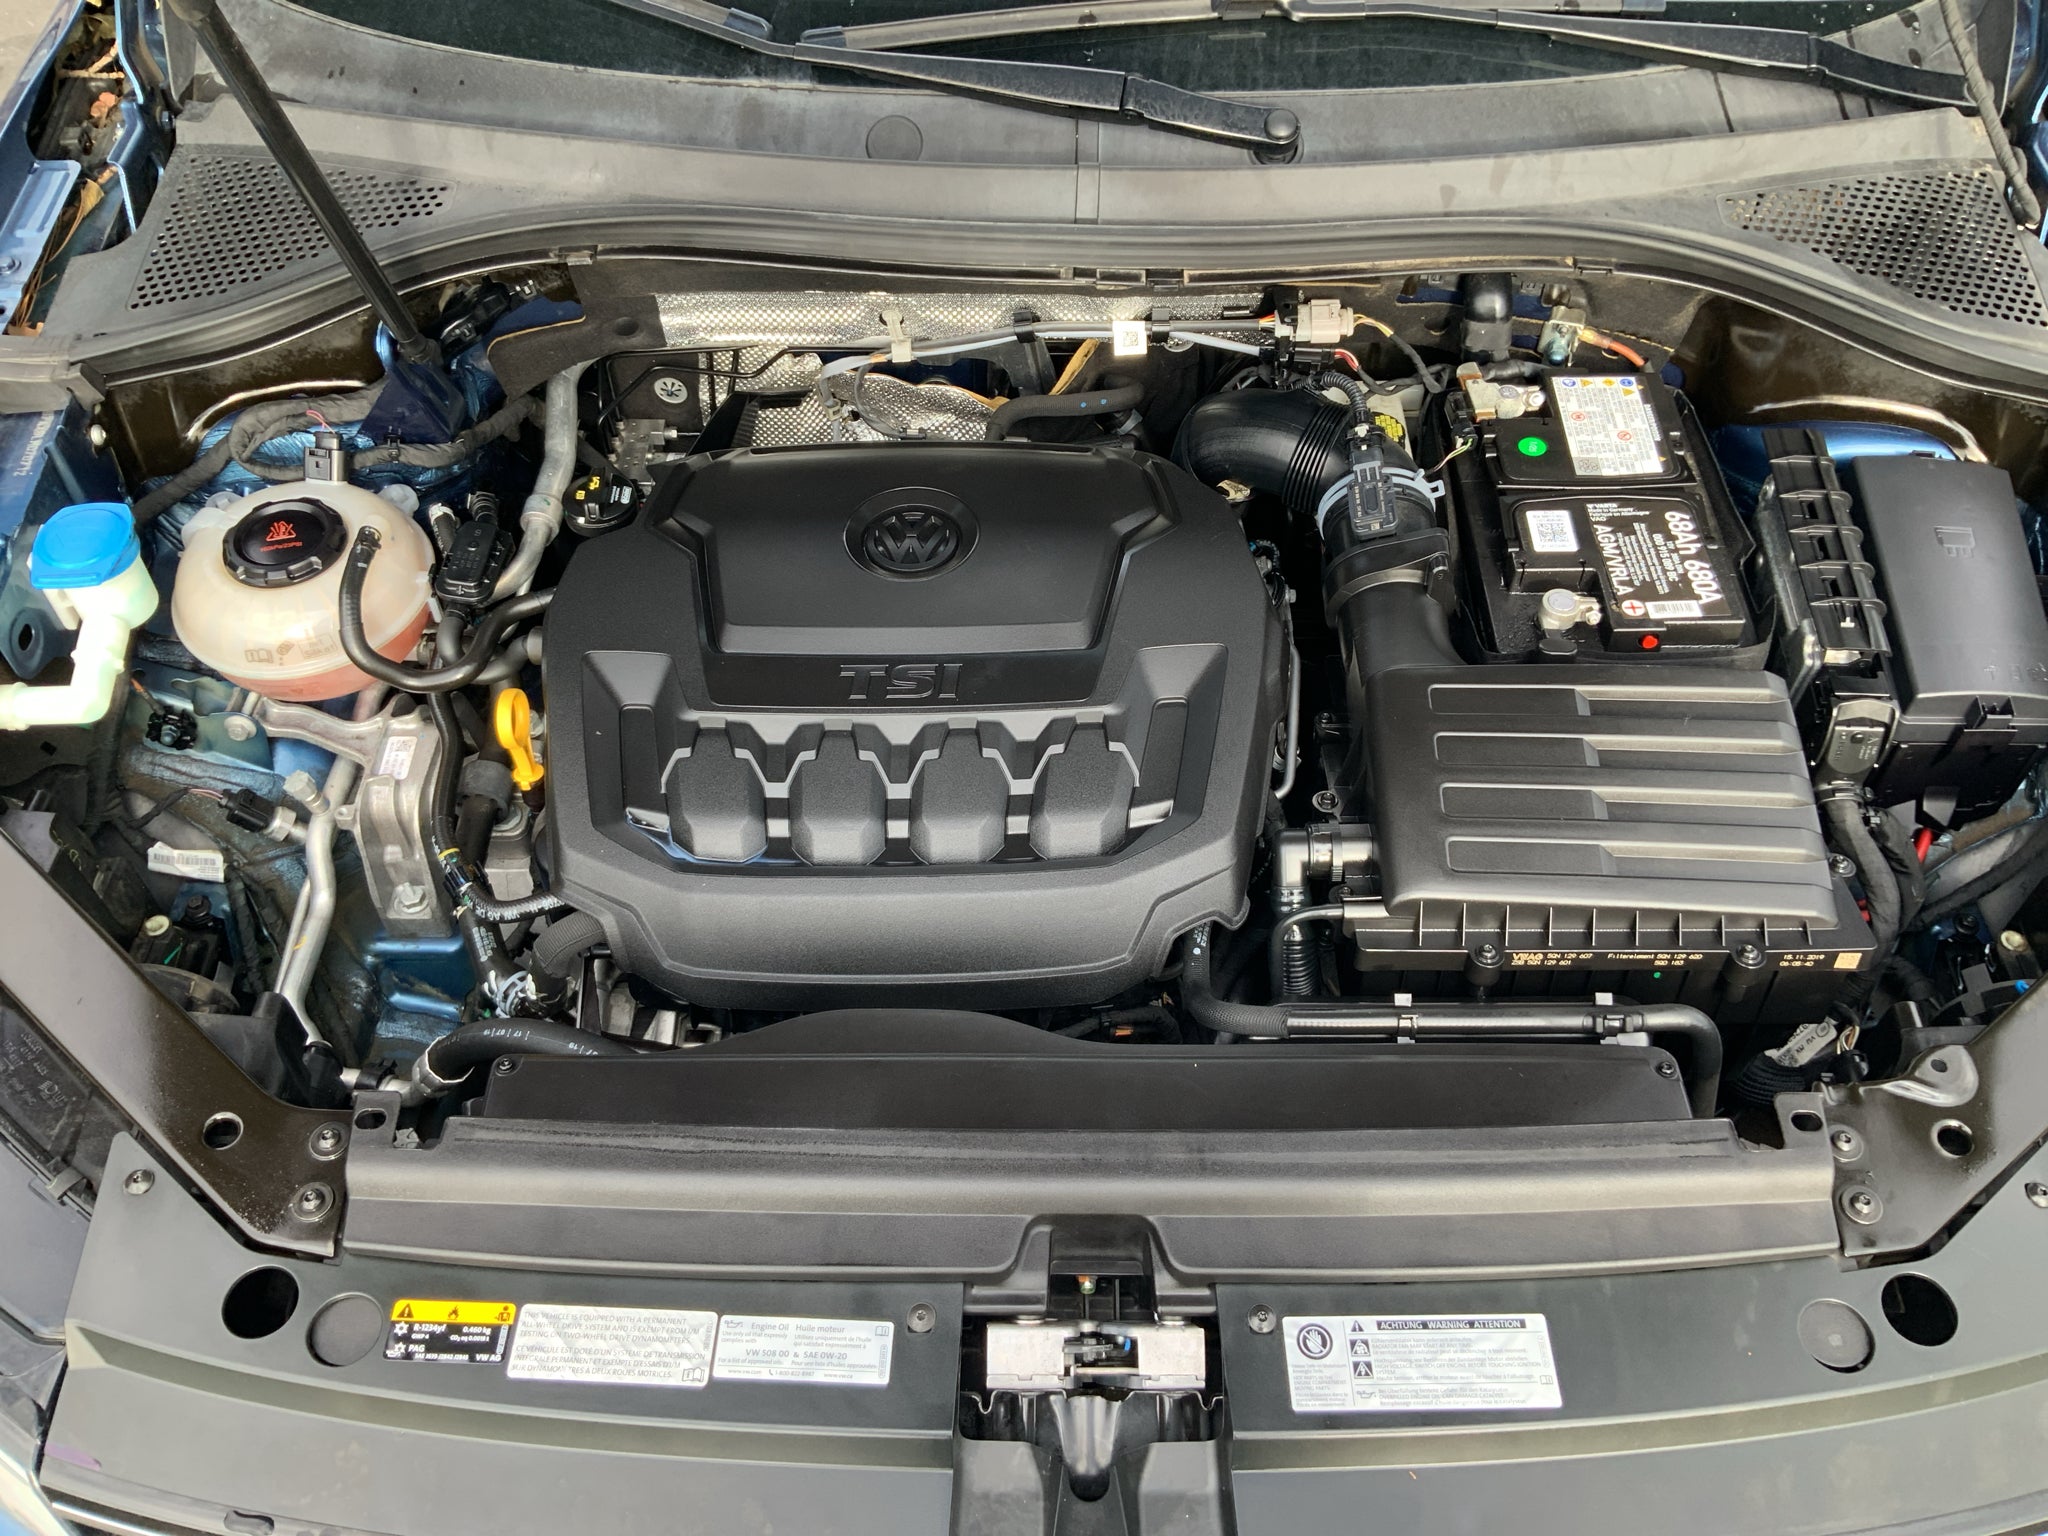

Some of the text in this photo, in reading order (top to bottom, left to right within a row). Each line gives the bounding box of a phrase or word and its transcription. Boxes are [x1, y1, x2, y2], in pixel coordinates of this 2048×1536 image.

[1664, 511, 1724, 605] 68Ah 680A
[839, 663, 963, 700] TSI
[541, 1312, 571, 1320] VEHICLE
[580, 1313, 614, 1322] EQUIPPED
[643, 1316, 687, 1325] PERMANENT
[413, 1323, 447, 1334] R-1234yf
[481, 1326, 492, 1335] kg
[562, 1322, 583, 1330] DRIVE
[584, 1323, 611, 1331] SYSTEM
[637, 1326, 665, 1334] EXEMPT
[751, 1322, 789, 1331] Engine Oil
[795, 1324, 845, 1333] Huile moteur
[1380, 1320, 1521, 1330] ACHTUNG WARNING ATTENTION
[519, 1330, 549, 1338] TESTING
[608, 1334, 630, 1342] DRIVE
[408, 1344, 425, 1352] PAG
[560, 1346, 573, 1354] EST
[653, 1351, 705, 1360] TRANSMISSION
[552, 1355, 592, 1364] PERMANENT
[745, 1348, 761, 1357] VW
[762, 1349, 777, 1357] 508
[778, 1350, 790, 1358] 00
[803, 1351, 819, 1359] SAE
[820, 1351, 848, 1360] 0W-20
[592, 1367, 612, 1375] DEUX
[612, 1368, 636, 1376] ROUES
